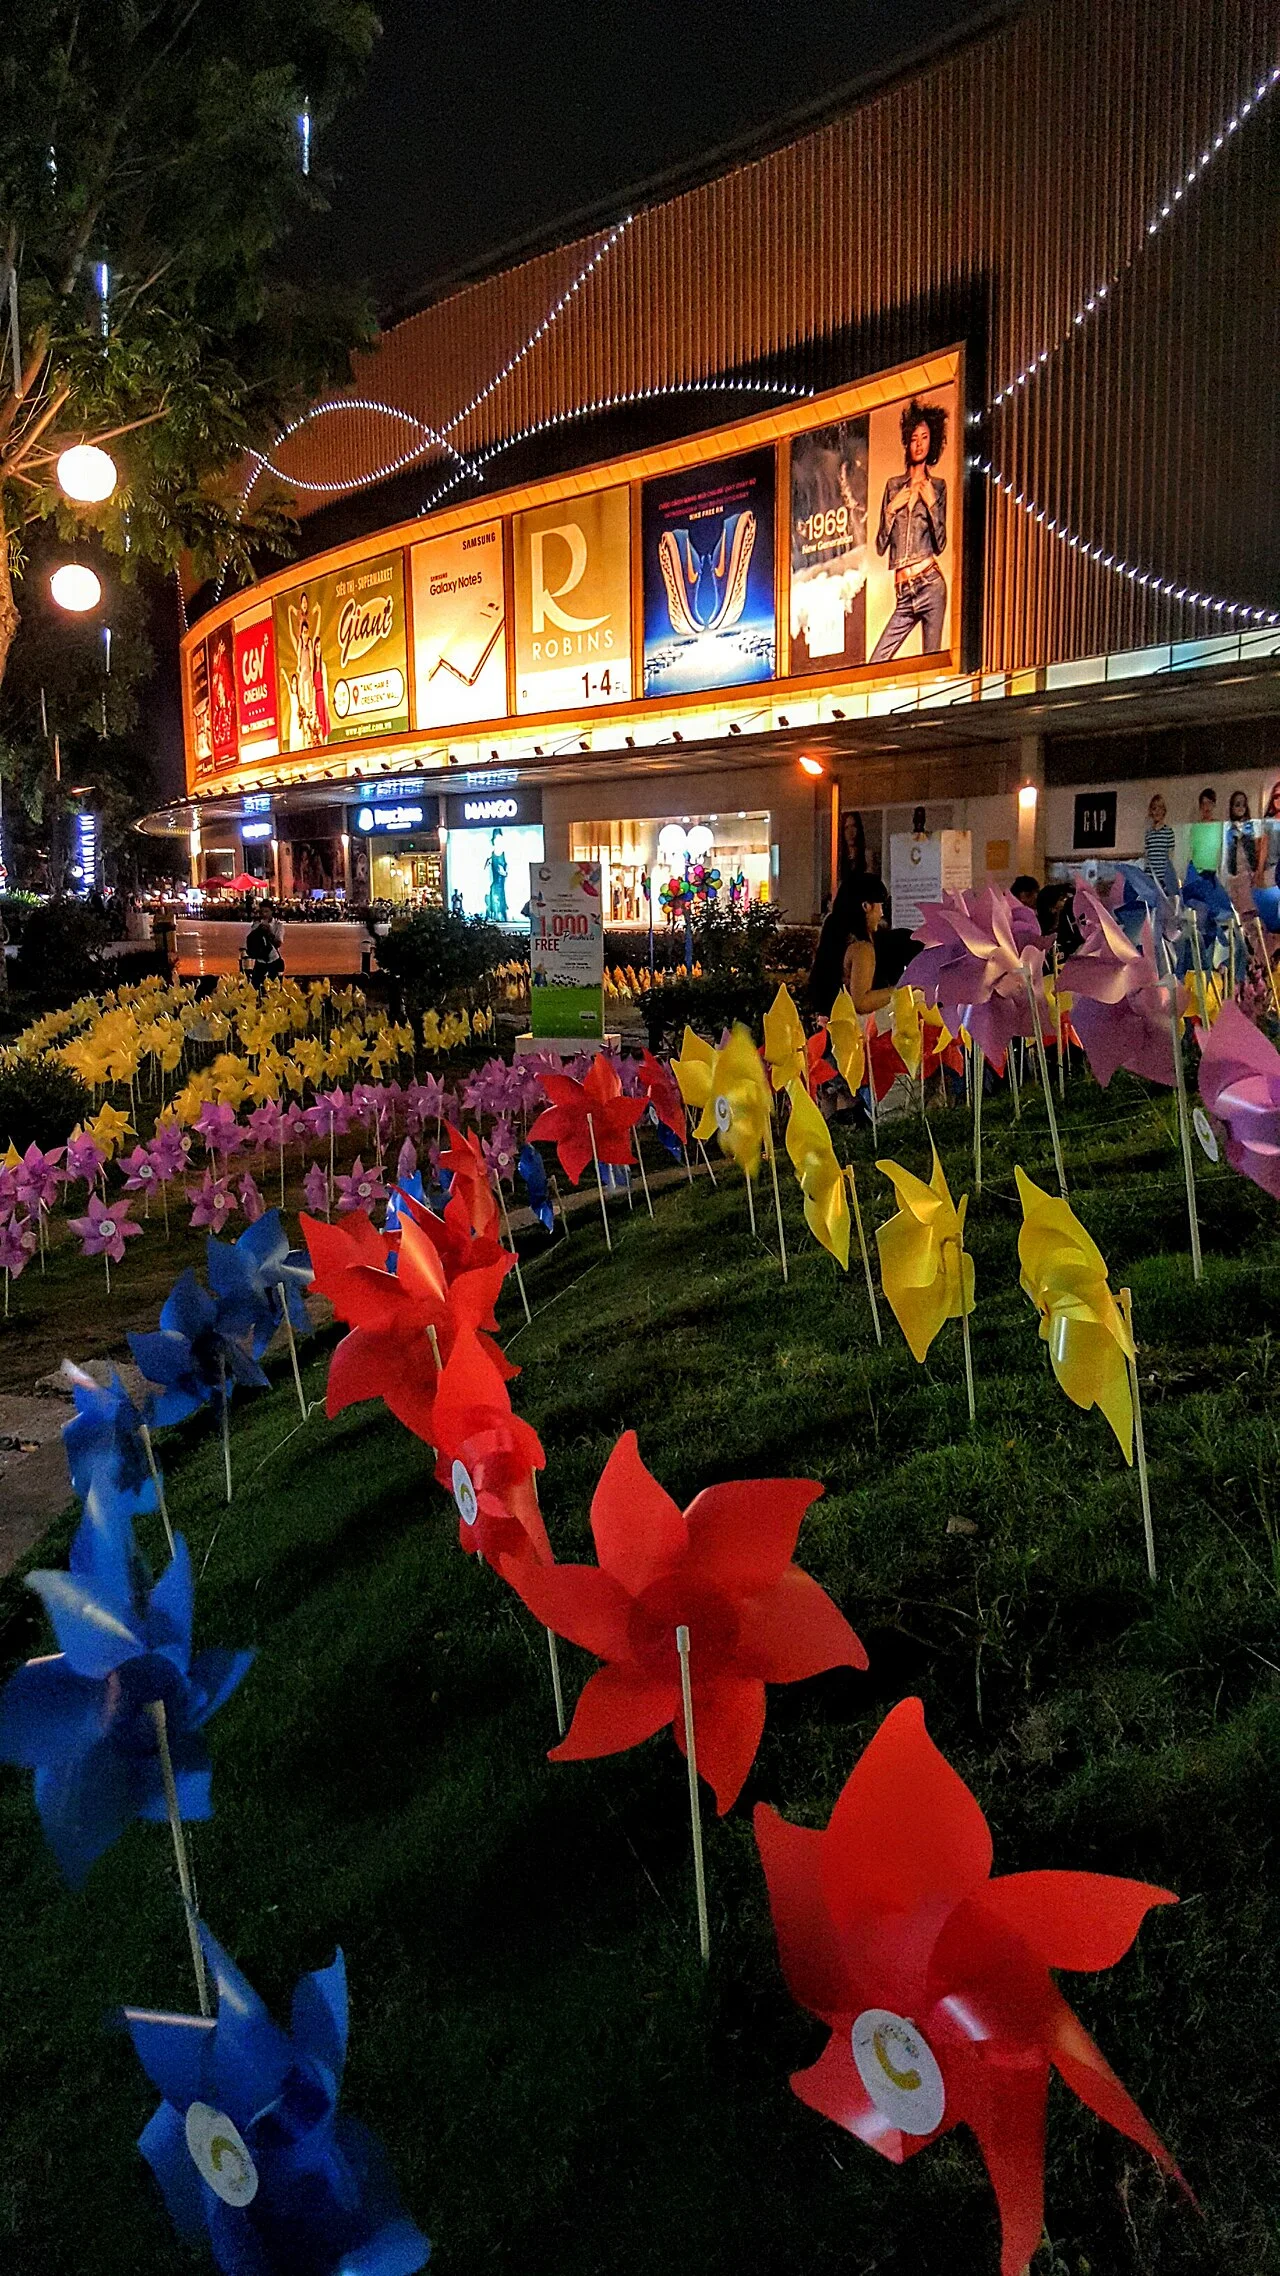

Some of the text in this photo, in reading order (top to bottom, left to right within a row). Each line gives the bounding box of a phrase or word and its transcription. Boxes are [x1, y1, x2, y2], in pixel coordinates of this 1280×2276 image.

[806, 506, 848, 540] 1969
[462, 532, 496, 550] SAMSUNG
[802, 535, 854, 554] New Generation
[357, 567, 393, 590] SUPERMARKET
[429, 580, 457, 596] Galaxy
[531, 523, 612, 634] R
[339, 599, 392, 665] Giant
[532, 629, 614, 661] ROBINS
[242, 644, 265, 686] CGV
[243, 683, 268, 705] CINEMAS
[581, 669, 612, 699] 1-4
[464, 798, 518, 820] MANGO
[1084, 809, 1107, 831] GAP
[540, 913, 588, 937] 1.000
[535, 938, 560, 951] FREE
